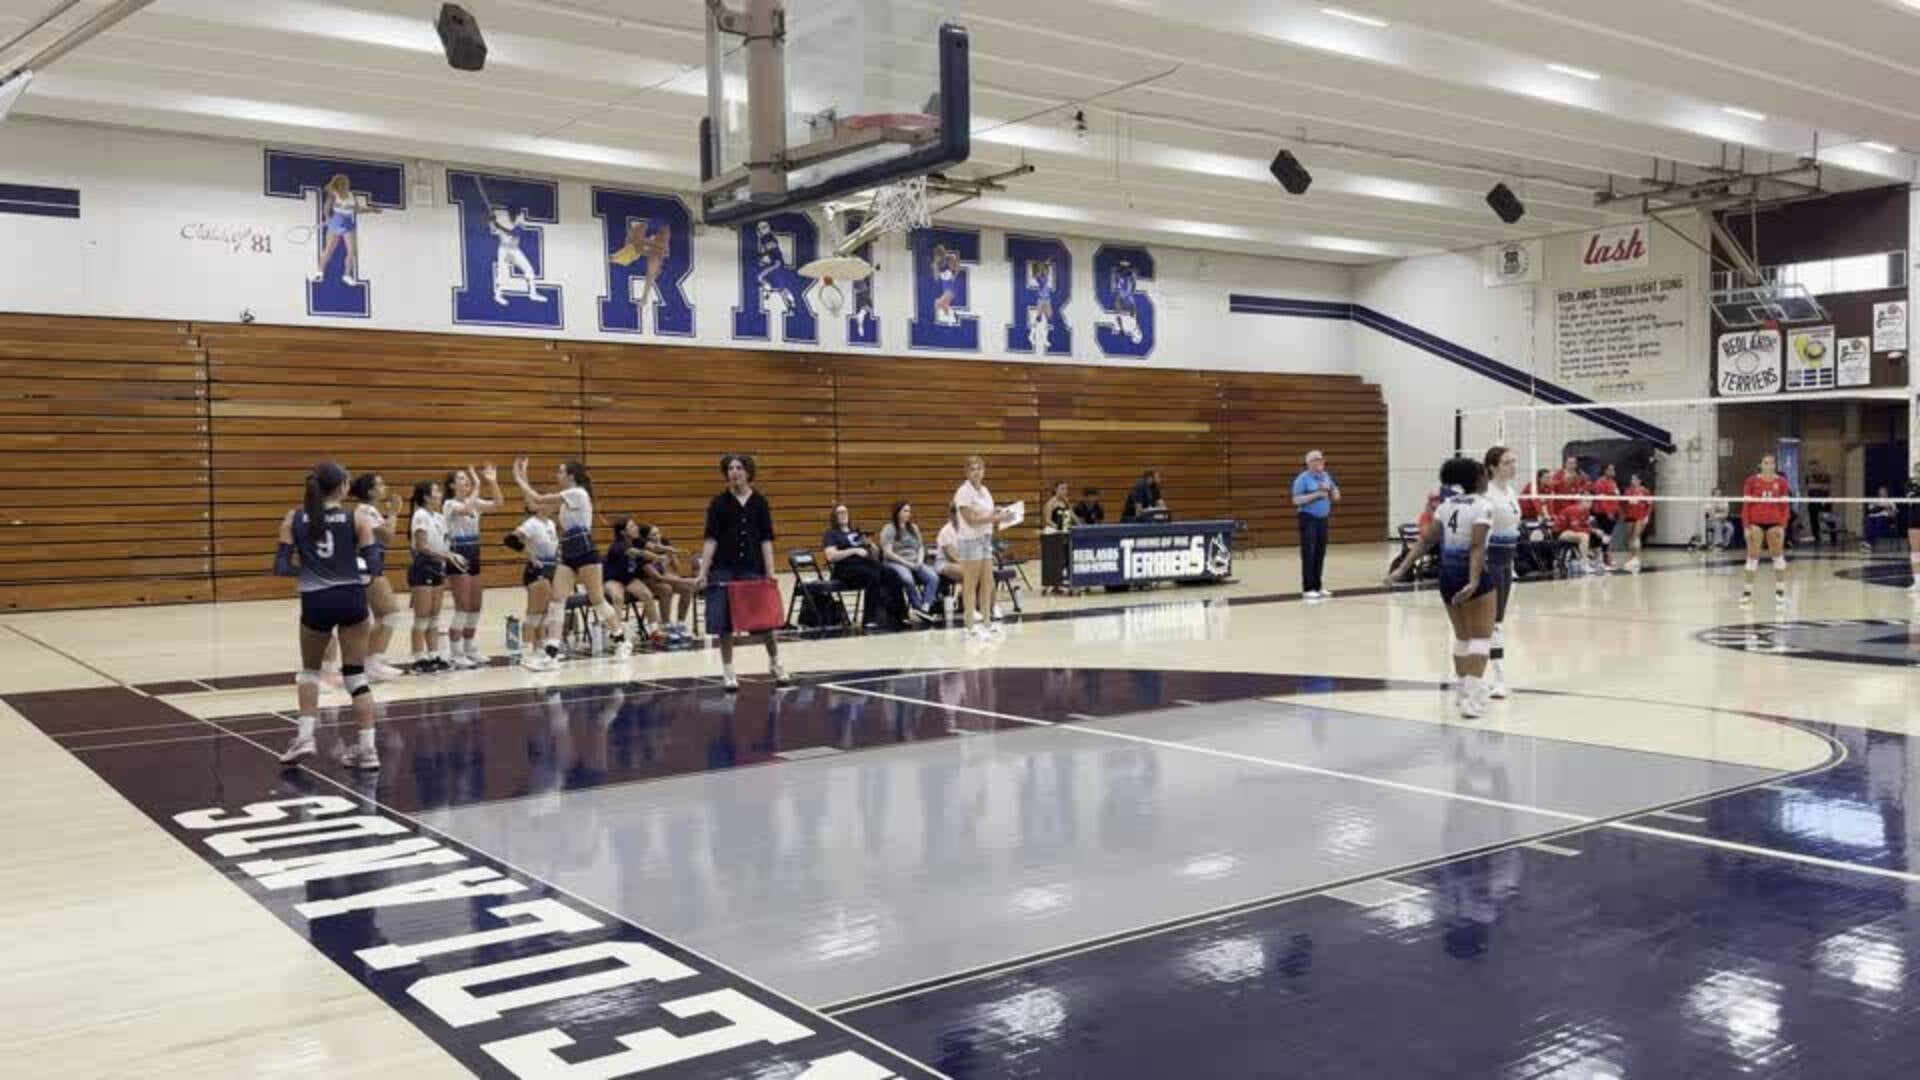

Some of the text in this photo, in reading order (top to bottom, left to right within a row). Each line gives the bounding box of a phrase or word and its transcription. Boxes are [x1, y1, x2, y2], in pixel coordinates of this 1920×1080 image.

[264, 150, 1158, 360] TERRIERS
[1722, 367, 1778, 391] TERRIERS
[1448, 510, 1460, 534] 4
[172, 795, 906, 1080] EDLANDS
